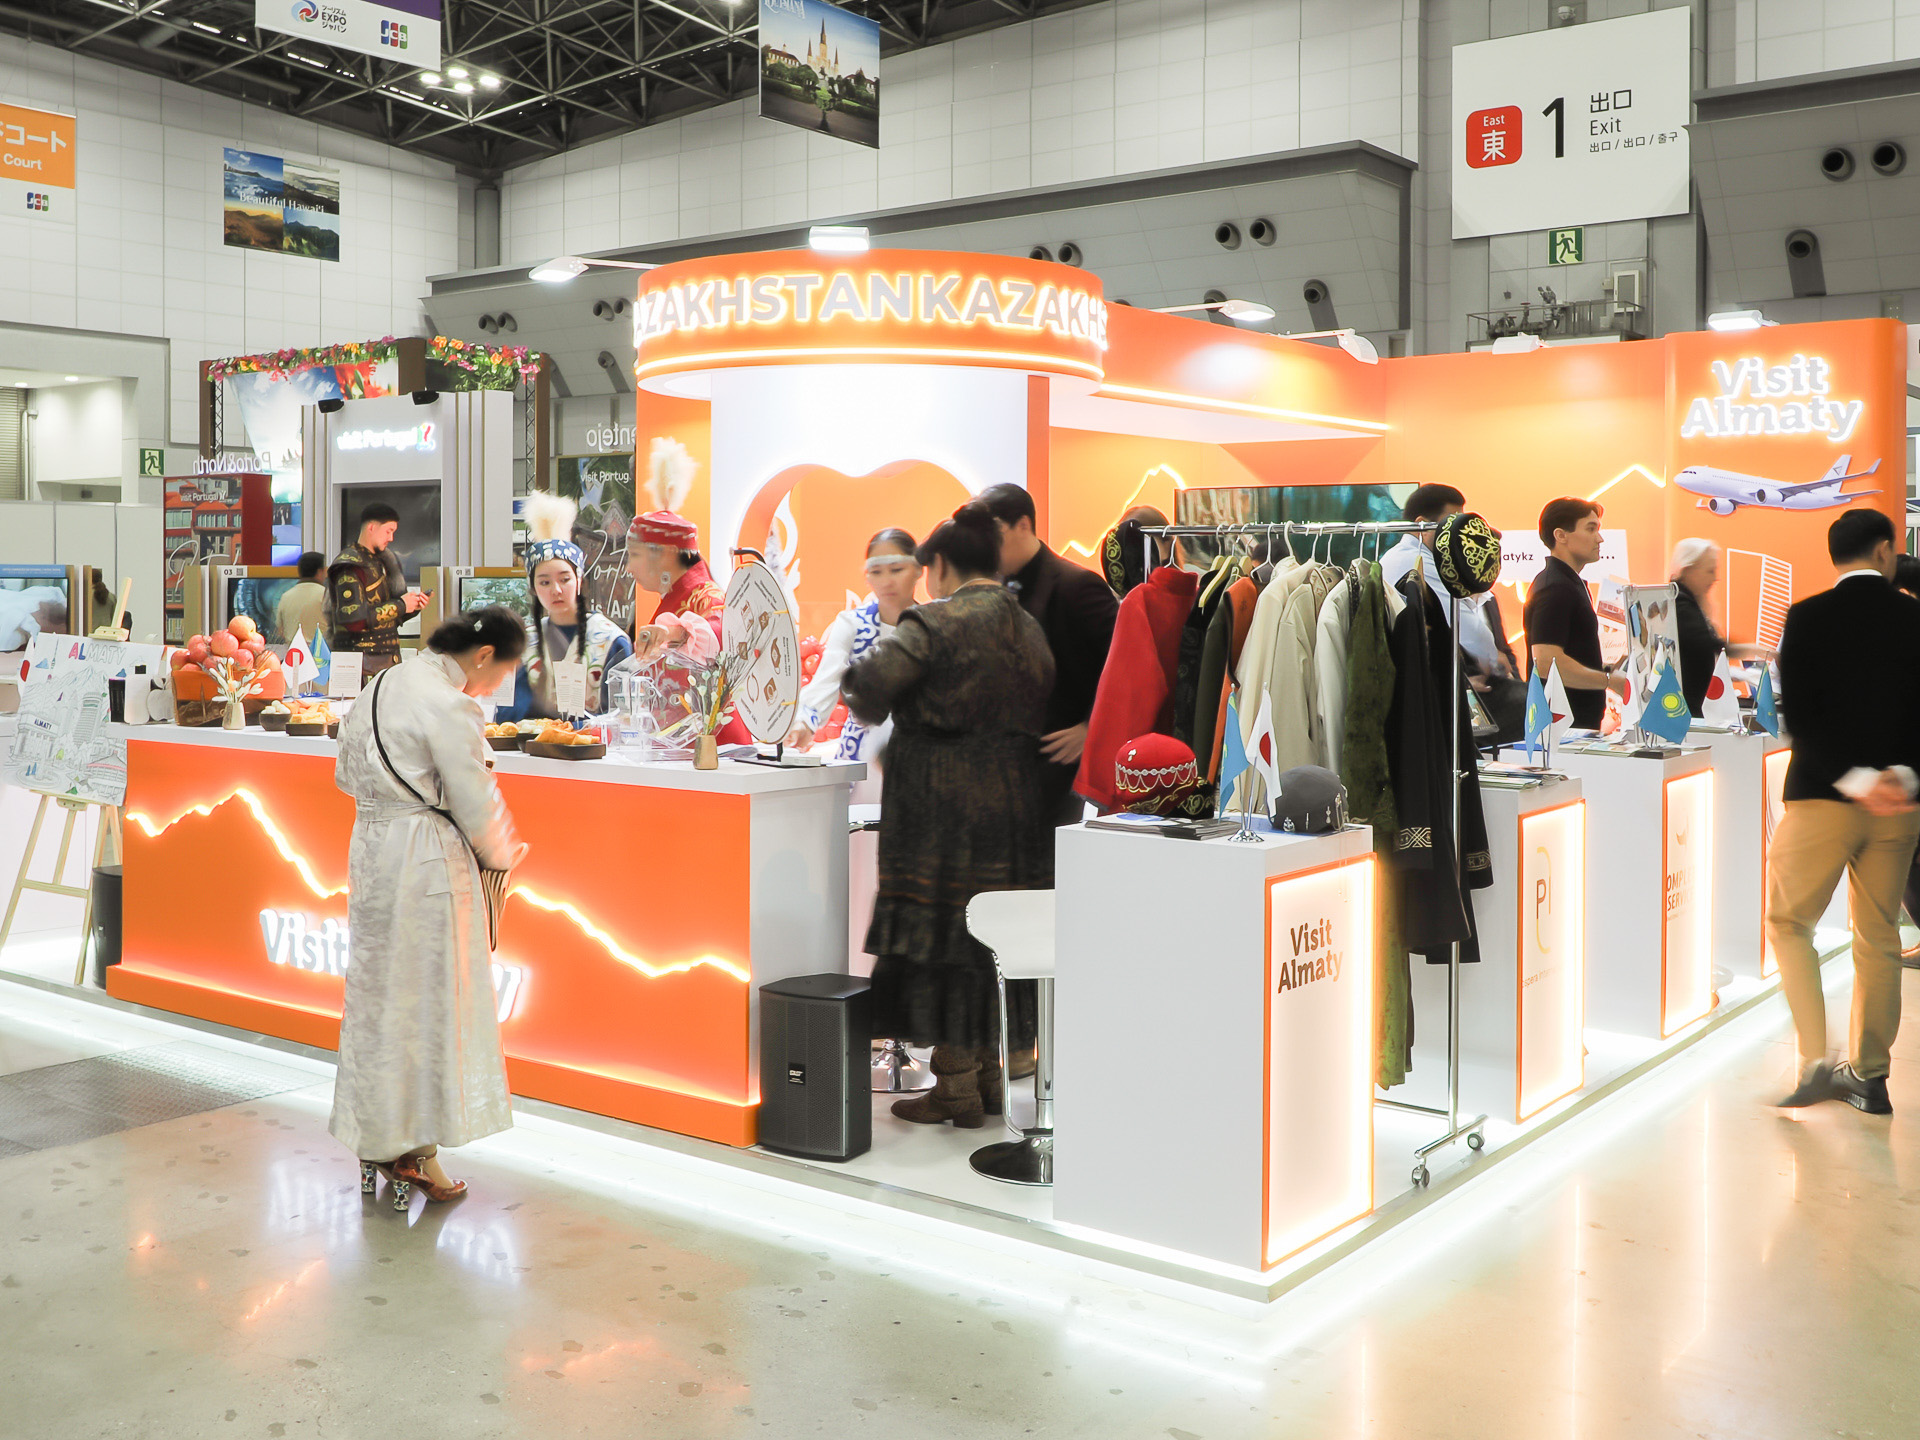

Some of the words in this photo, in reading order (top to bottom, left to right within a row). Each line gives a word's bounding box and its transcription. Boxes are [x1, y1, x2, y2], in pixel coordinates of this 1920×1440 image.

[321, 12, 347, 26] EXPO
[321, 21, 347, 33] ジャパン
[380, 25, 408, 46] JCB
[1590, 89, 1632, 113] 出口
[1483, 115, 1505, 127] East
[1541, 97, 1564, 158] 1
[1590, 117, 1621, 136] Exit
[1481, 129, 1506, 161] 東
[1589, 141, 1611, 153] 出口
[1623, 136, 1646, 149] 出口
[1657, 131, 1678, 144] 출구
[3, 153, 42, 171] Court
[240, 192, 286, 208] Beautiful
[1711, 354, 1830, 398] Visit
[1681, 395, 1863, 441] Almaty
[193, 490, 218, 503] Portugal
[611, 600, 634, 618] Ar
[68, 642, 127, 665] ALMATY
[34, 718, 52, 731] ALMATY
[259, 908, 350, 978] Visit
[1290, 918, 1332, 956] Visit
[1278, 950, 1343, 994] Almaty
